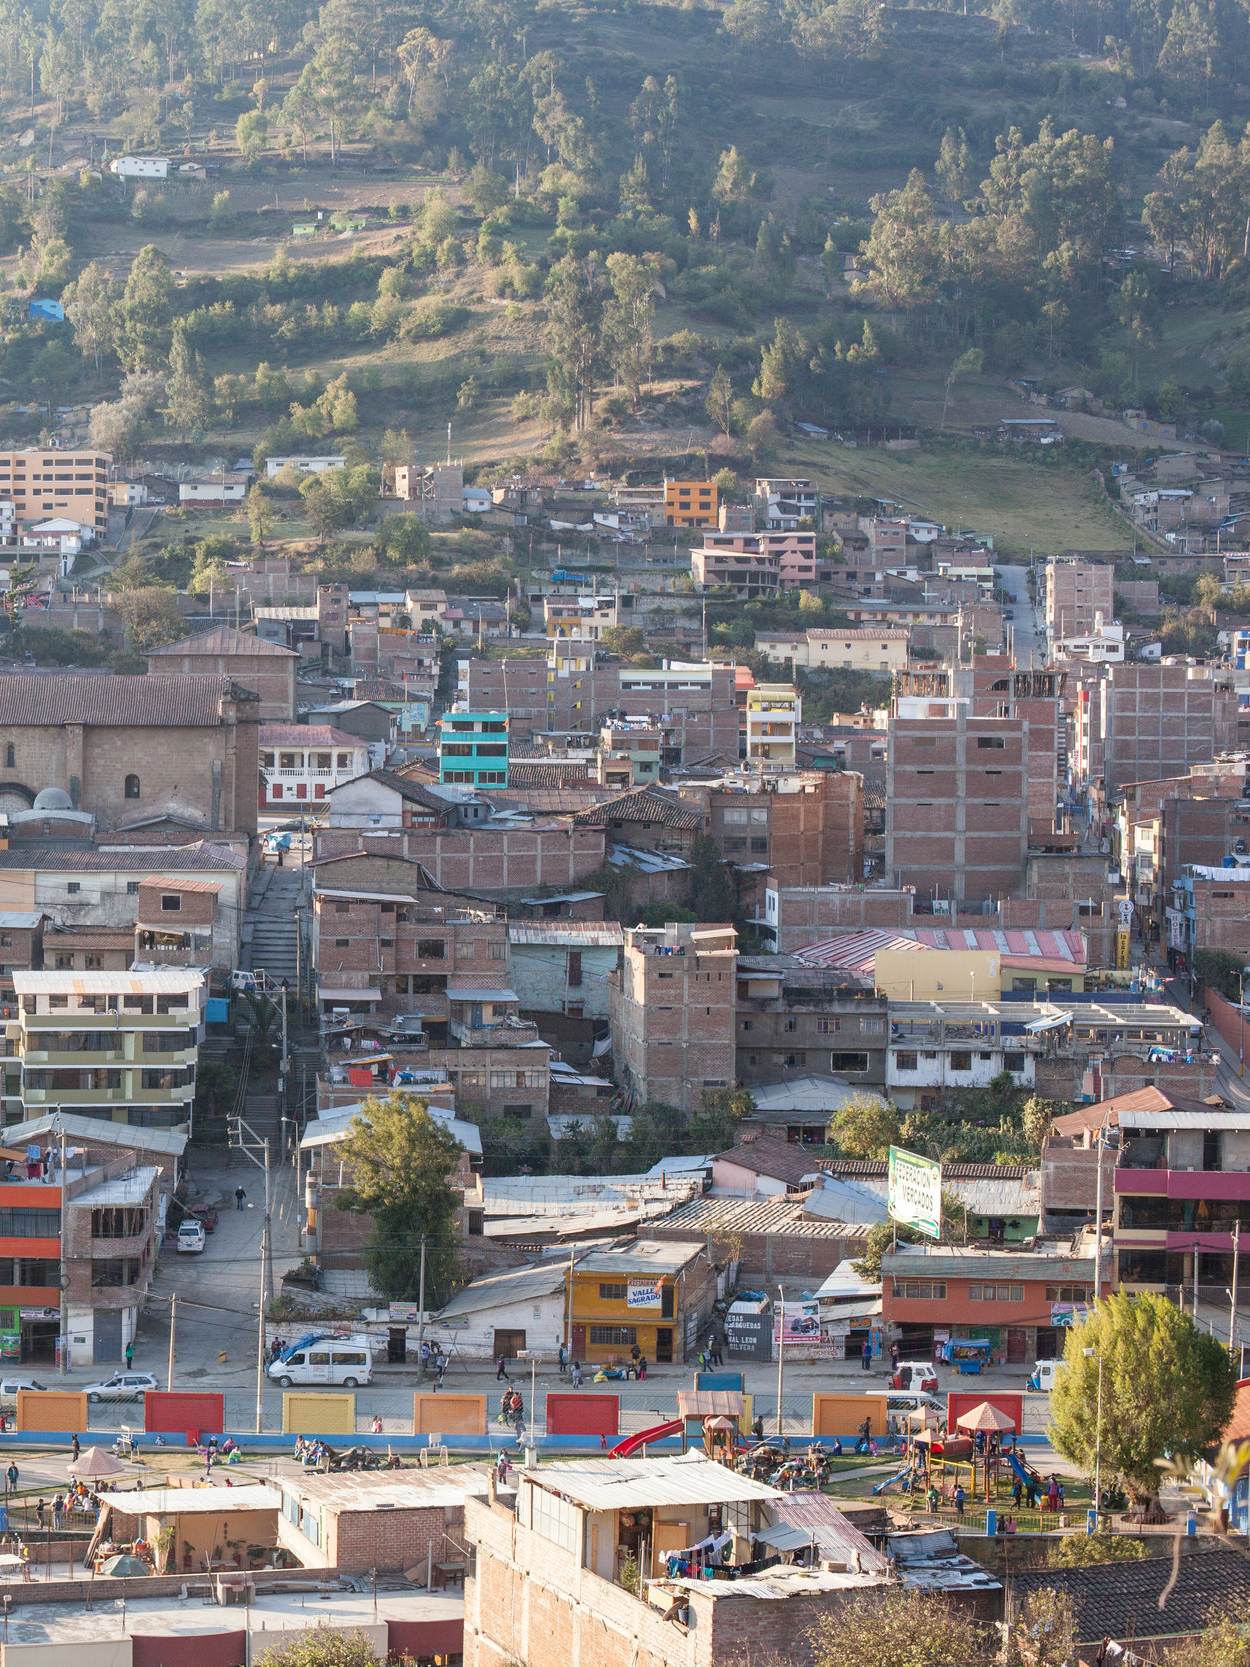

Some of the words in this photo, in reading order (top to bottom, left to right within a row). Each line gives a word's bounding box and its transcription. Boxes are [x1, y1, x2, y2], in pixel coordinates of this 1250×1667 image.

[902, 1184, 934, 1212] MERCADOS
[632, 1287, 655, 1297] VALLE
[628, 1293, 661, 1304] SAGRADO
